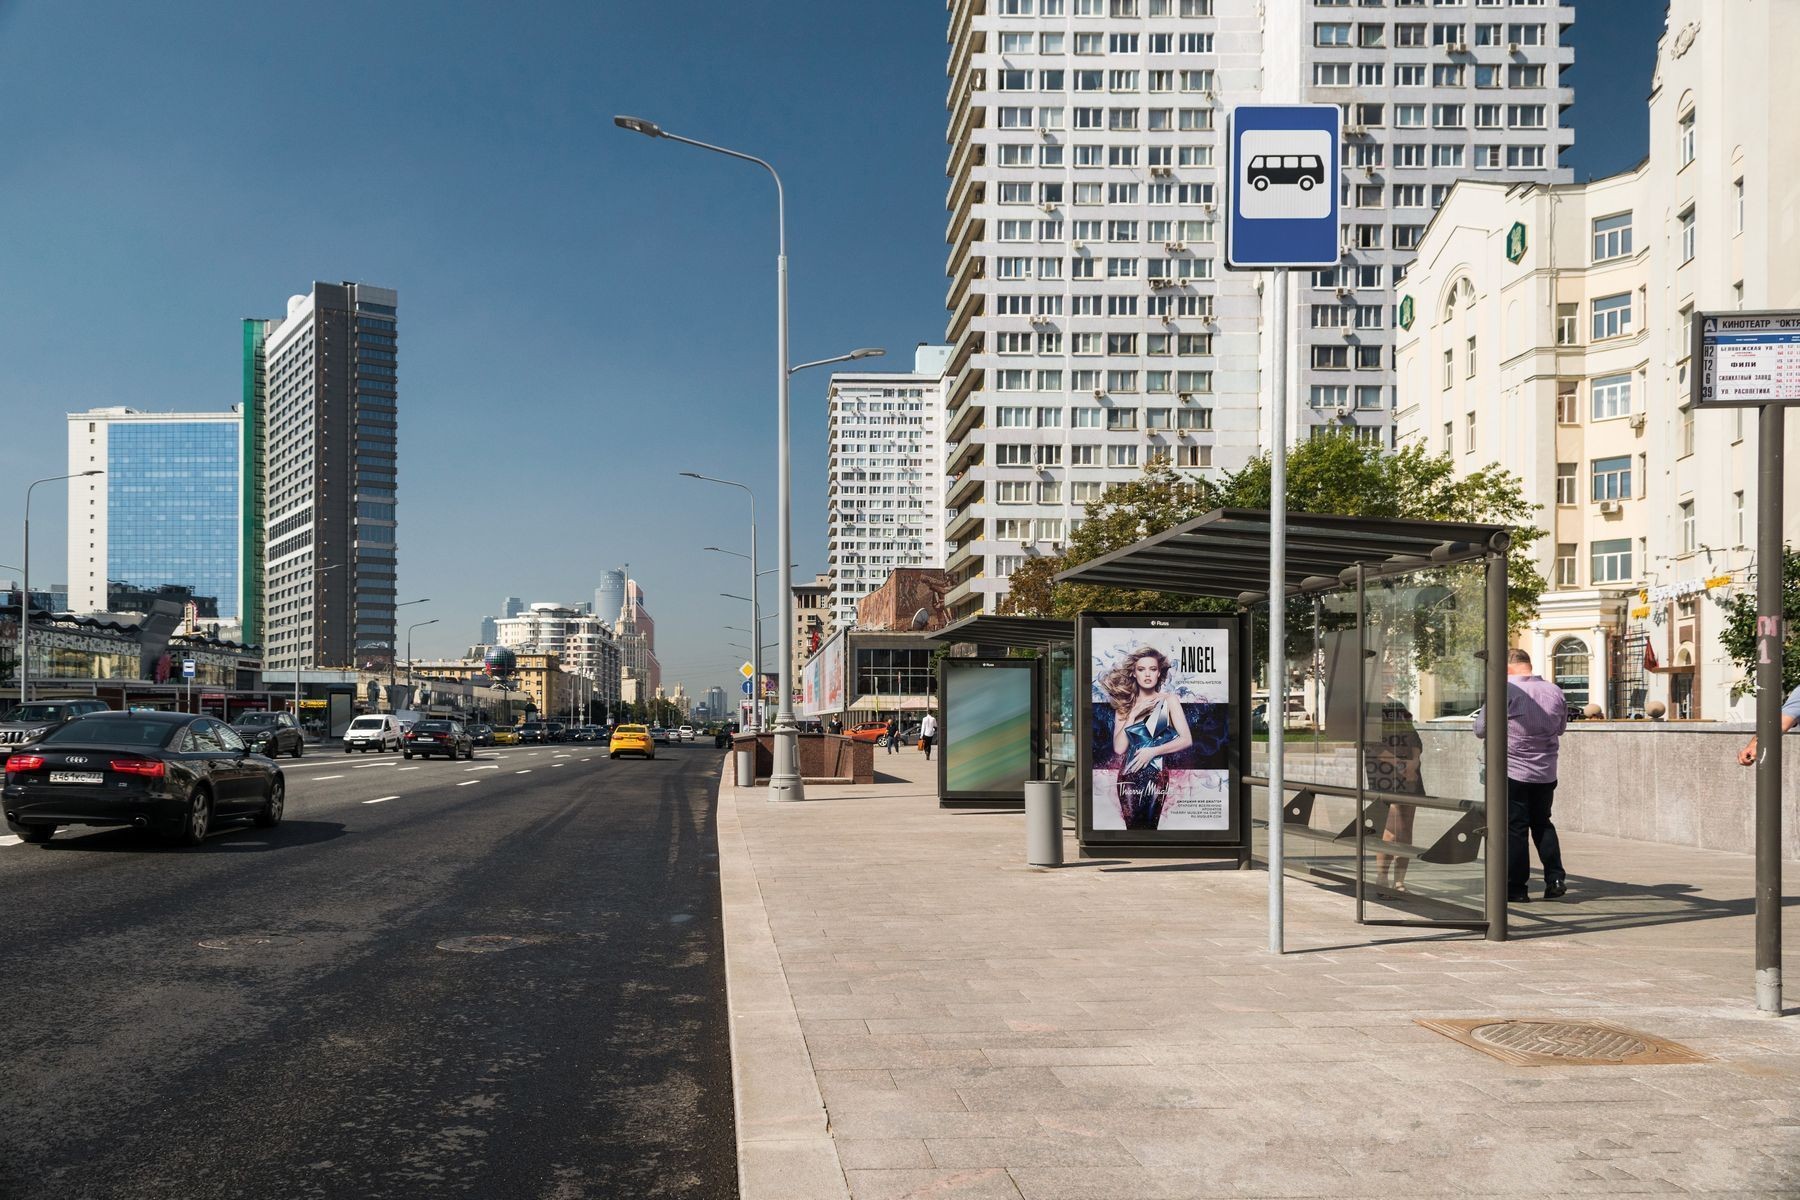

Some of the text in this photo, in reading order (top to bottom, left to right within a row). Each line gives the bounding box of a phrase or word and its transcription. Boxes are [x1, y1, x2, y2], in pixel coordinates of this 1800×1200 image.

[1722, 320, 1770, 328] КИНОТЕАТР
[1180, 646, 1216, 673] ANGEL
[1144, 780, 1172, 806] Mugl
